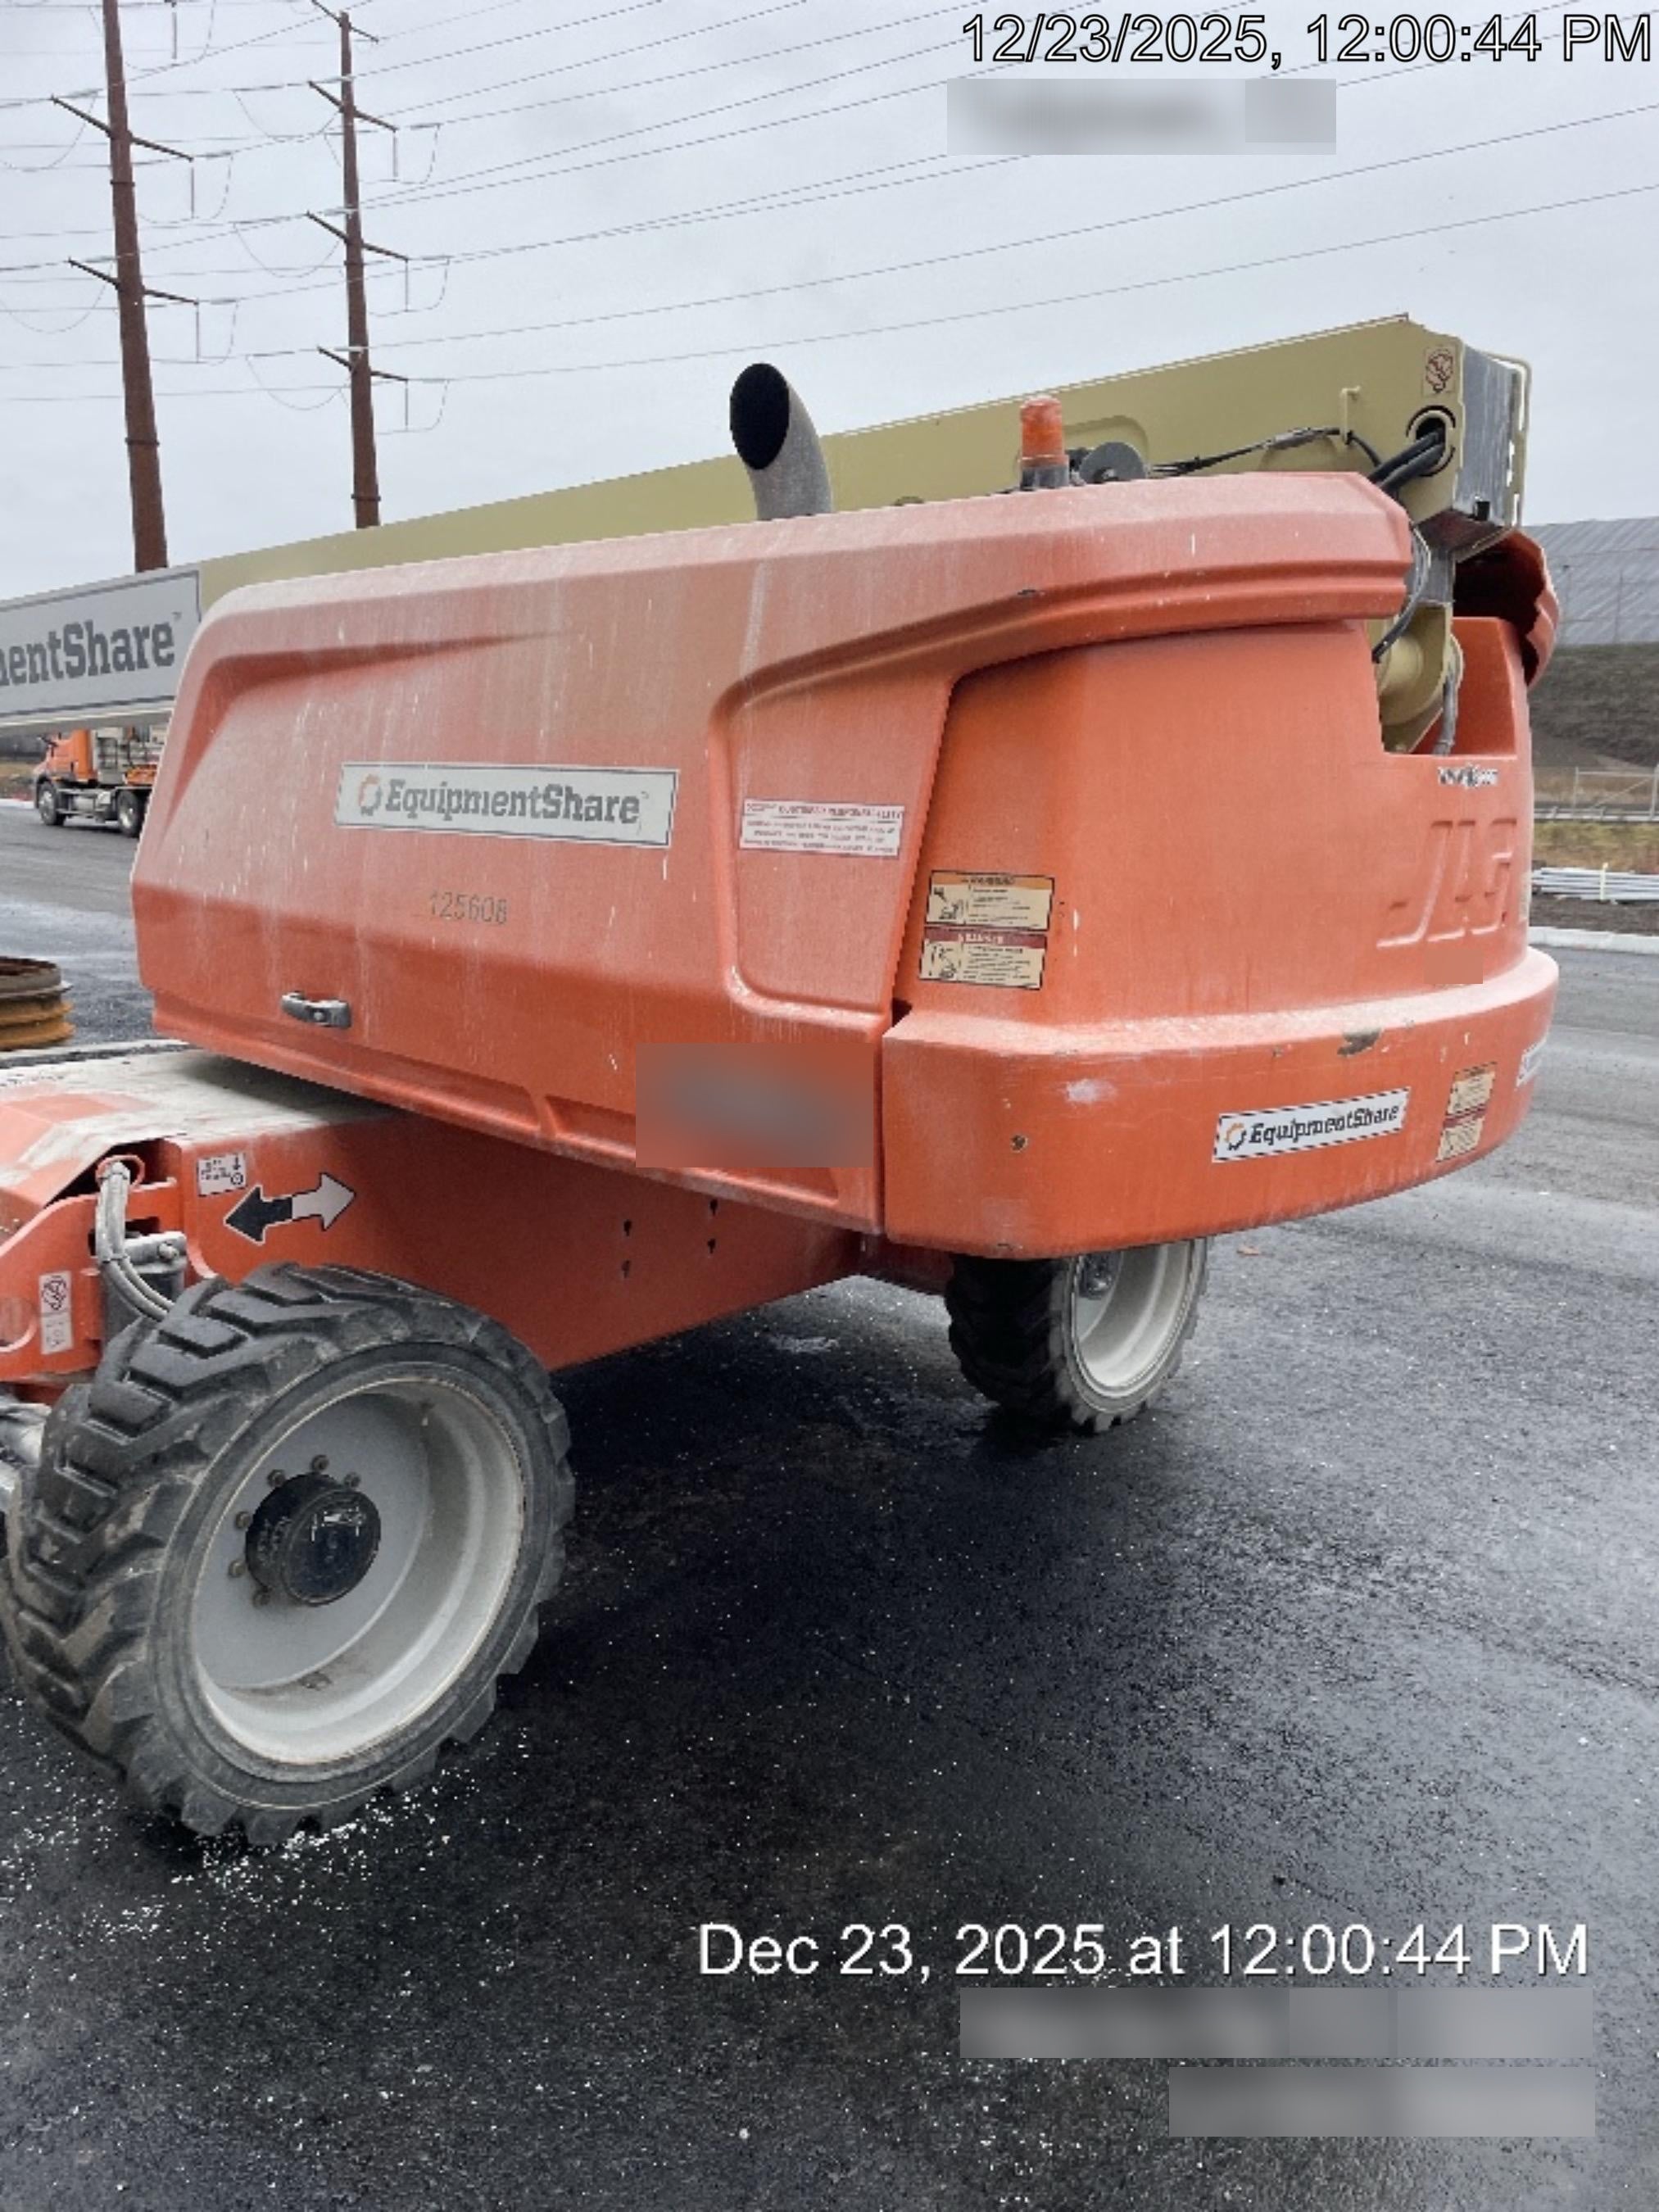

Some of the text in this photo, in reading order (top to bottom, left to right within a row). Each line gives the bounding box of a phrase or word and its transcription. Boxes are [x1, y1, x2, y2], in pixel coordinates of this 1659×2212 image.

[385, 778, 641, 826] EquipmentShare
[429, 891, 508, 925] 125608
[1249, 1104, 1399, 1148] EquipmentShare
